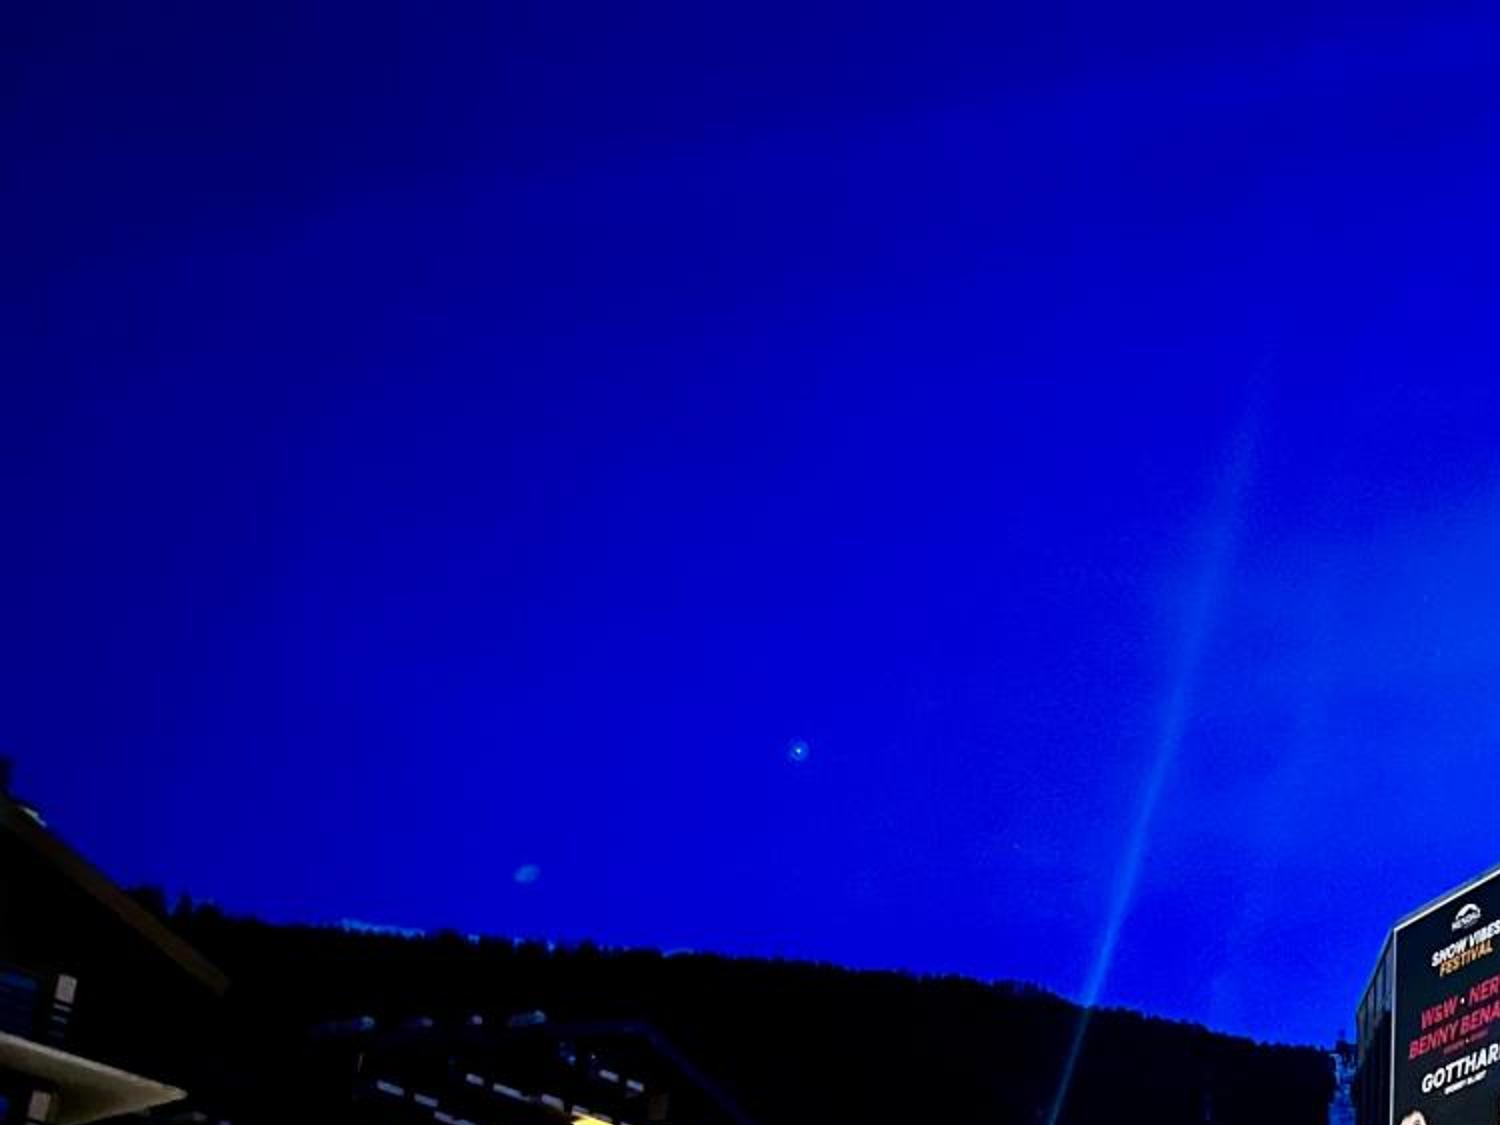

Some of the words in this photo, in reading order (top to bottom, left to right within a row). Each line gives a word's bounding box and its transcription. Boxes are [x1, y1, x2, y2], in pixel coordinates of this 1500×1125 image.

[1431, 937, 1468, 967] SNOW
[1440, 939, 1494, 977] FESTIVAL
[1408, 1018, 1460, 1060] BENNY
